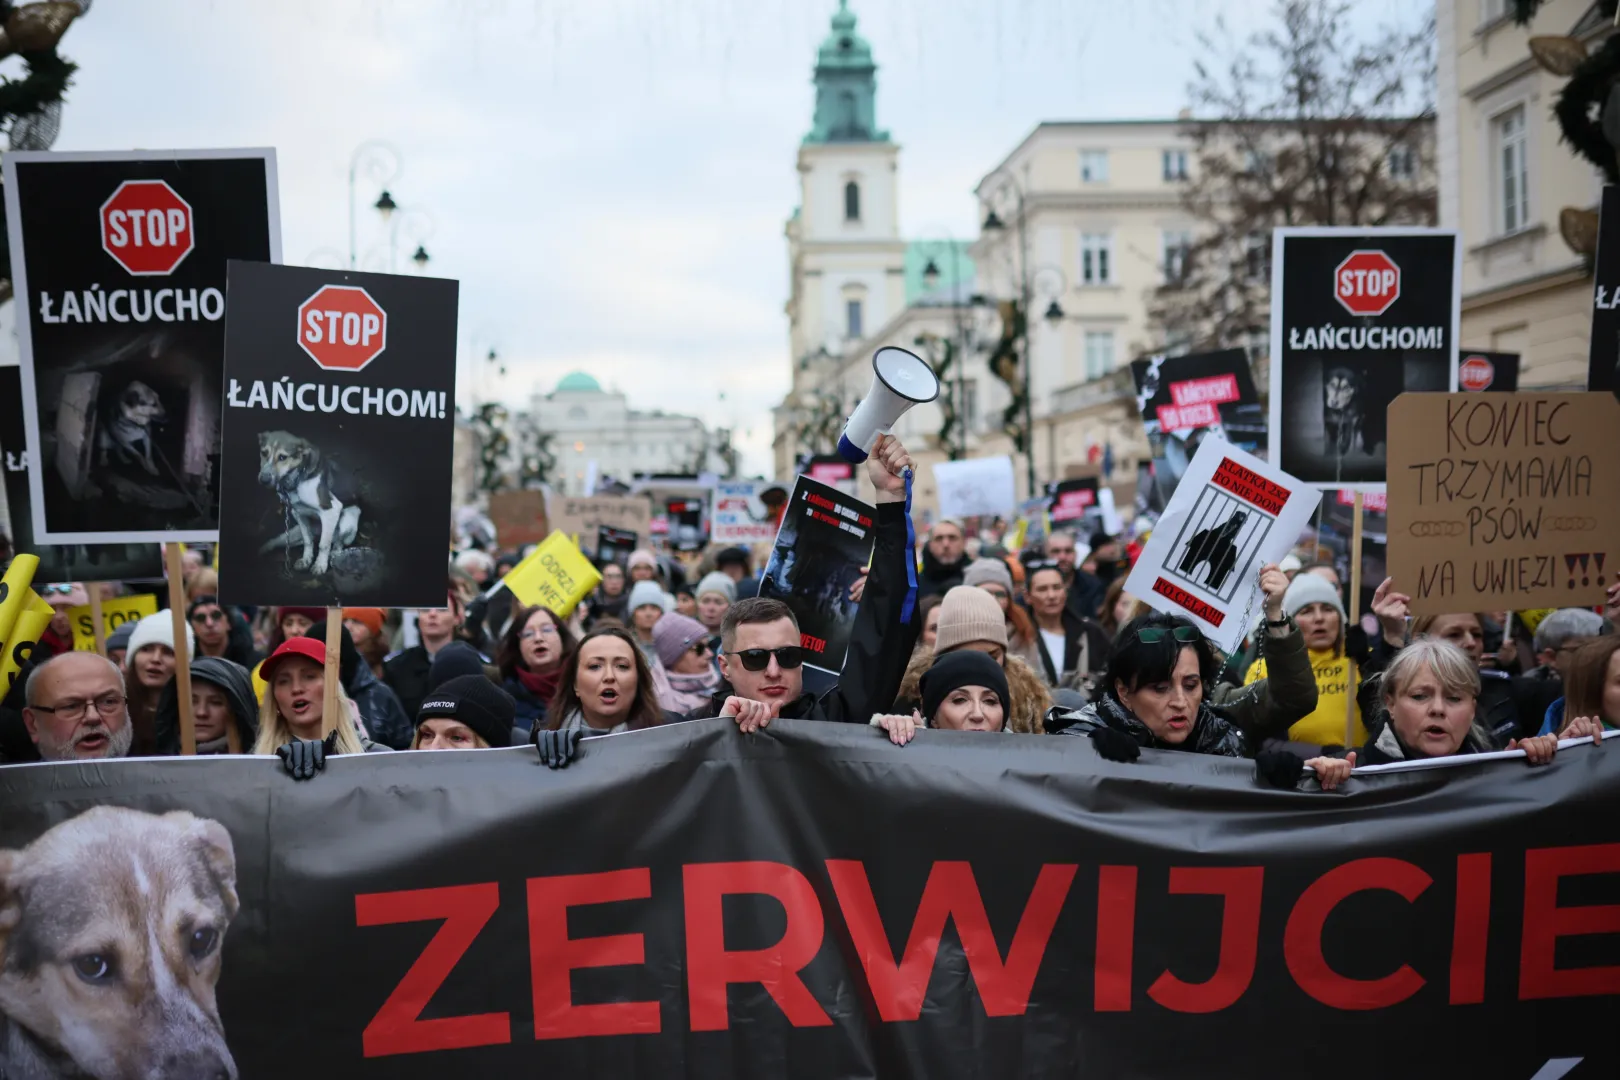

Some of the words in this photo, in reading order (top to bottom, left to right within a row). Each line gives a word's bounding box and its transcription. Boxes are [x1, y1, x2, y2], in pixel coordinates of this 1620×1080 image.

[109, 208, 186, 248] STOP
[40, 283, 224, 324] ŁAŃCUCHO
[1340, 269, 1396, 300] STOP
[305, 309, 380, 348] STOP
[1289, 322, 1443, 351] ŁAŃCUCHOM!
[1463, 366, 1491, 382] STOP
[227, 376, 446, 419] ŁAŃCUCHOM!
[1447, 399, 1571, 453] KONIEC
[1215, 472, 1231, 487] TO
[1230, 482, 1253, 499] NIE
[1253, 491, 1283, 514] DOM
[1220, 460, 1267, 491] KLATKA
[1408, 455, 1592, 505] TRZYMANIA
[1466, 498, 1542, 546] PSÓW
[1417, 560, 1455, 599] NA
[1317, 667, 1343, 678] TOP
[422, 701, 456, 710] INSPEKTOR
[354, 842, 1620, 1058] ZERWIJCIE
